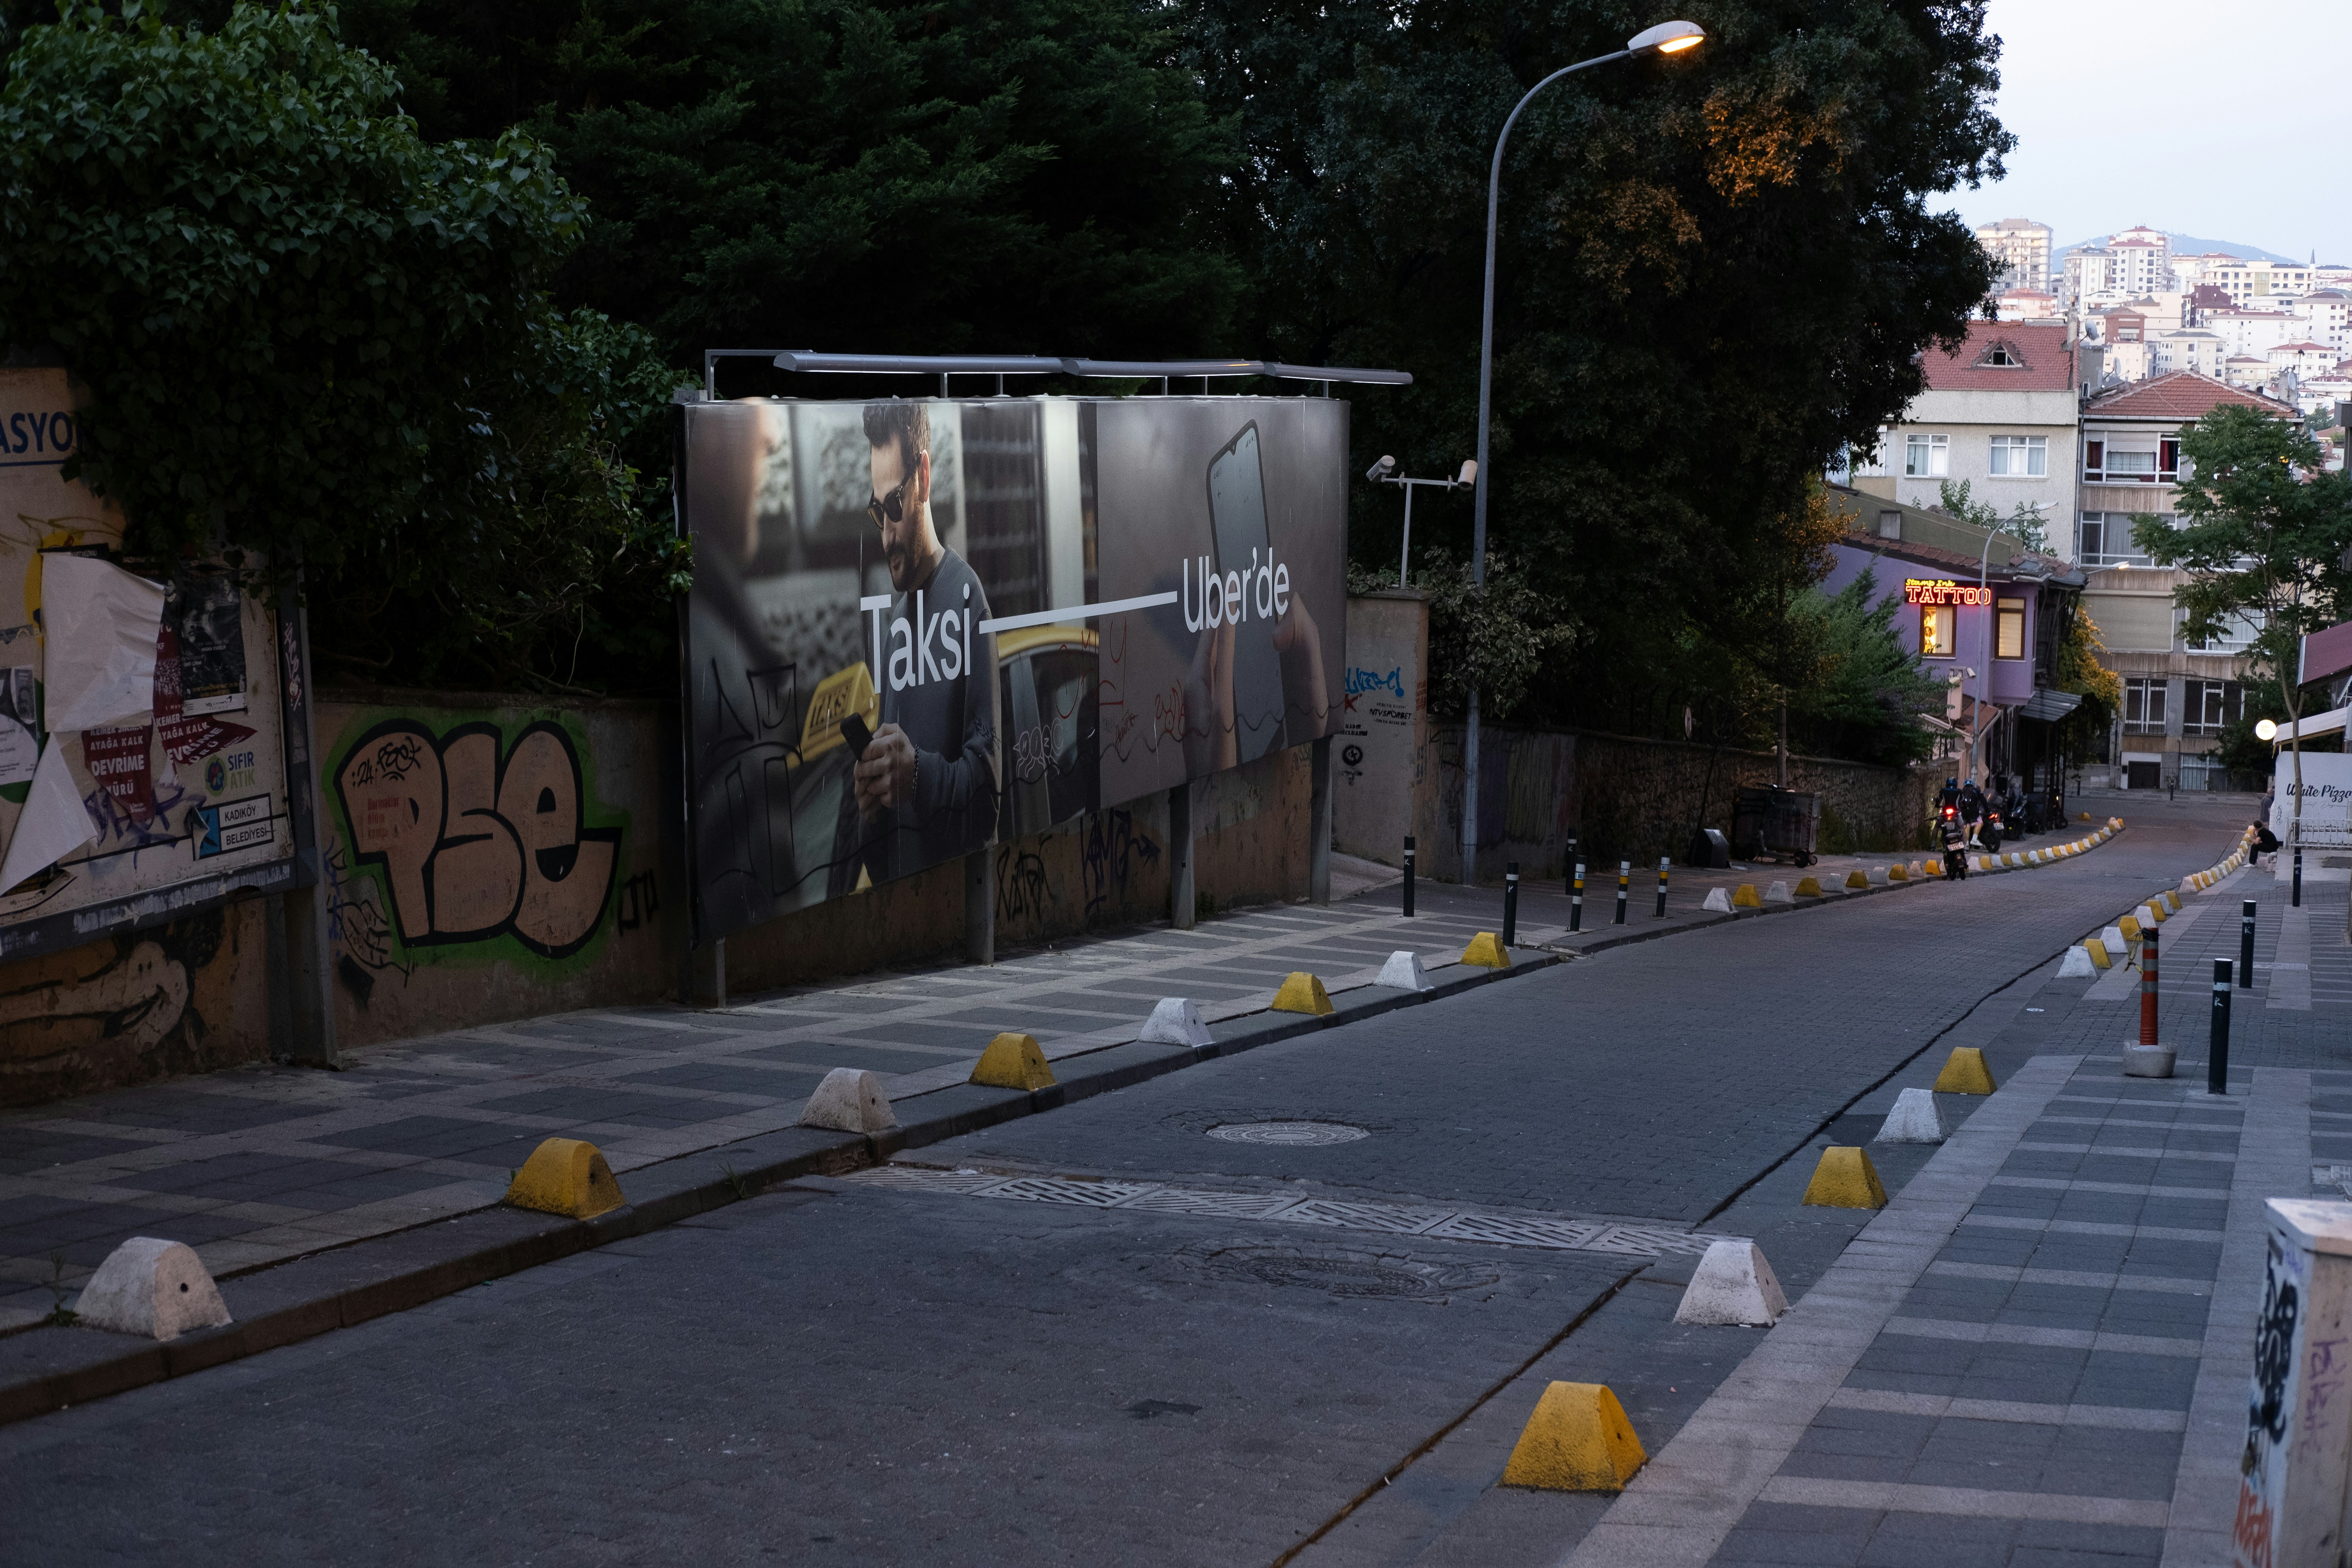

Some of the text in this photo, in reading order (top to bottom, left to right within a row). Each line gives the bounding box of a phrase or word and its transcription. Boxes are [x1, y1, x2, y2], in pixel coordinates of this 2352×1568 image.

[1906, 578, 1935, 587] Stamp
[1905, 585, 1991, 605] TATTOO
[860, 583, 971, 694] Taksi
[1183, 547, 1289, 633] Uber'de
[156, 713, 181, 727] KEMER
[1370, 709, 1412, 720] NTVSPORBET
[162, 721, 211, 740] YAĞA KALK
[90, 735, 144, 751] AYAĞA KALK
[167, 727, 223, 764] EVRİME
[188, 741, 219, 763] ÜRÜ
[91, 752, 145, 776] DEVRİME
[228, 752, 254, 771] SIFIR
[106, 779, 134, 796] YÜRÜ
[230, 769, 255, 789] ATIK
[2321, 785, 2352, 802] Pizza
[225, 804, 256, 822] KADIKÖY
[226, 824, 266, 845] BELEDİYESİ
